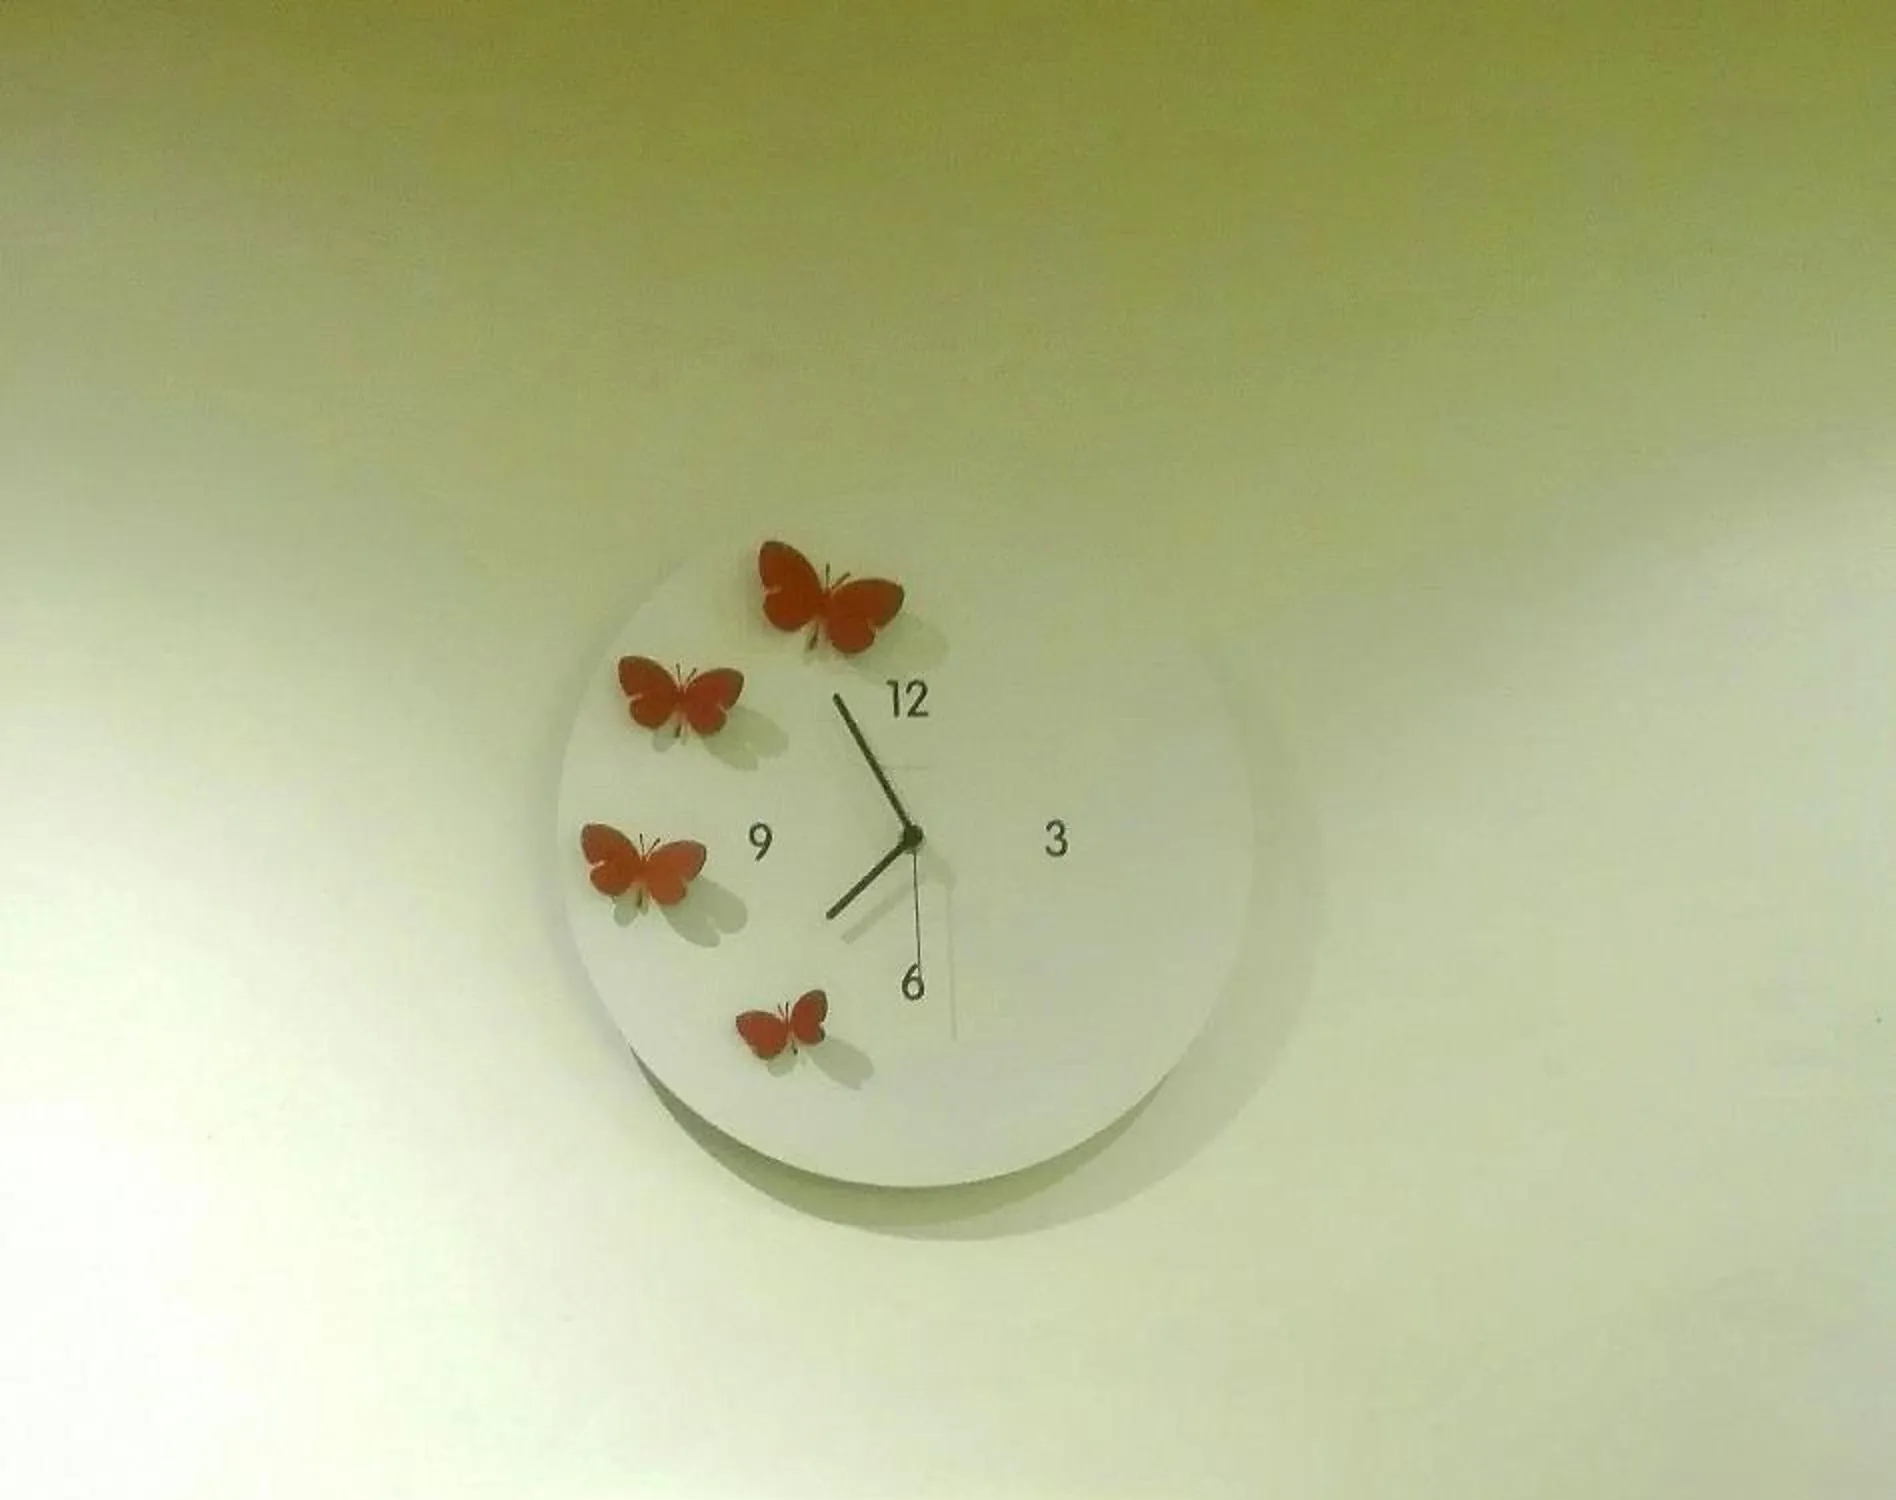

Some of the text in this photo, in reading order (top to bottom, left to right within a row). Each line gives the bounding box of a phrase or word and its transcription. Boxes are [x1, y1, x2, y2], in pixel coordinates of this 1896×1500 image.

[886, 679, 929, 717] 12
[749, 822, 773, 861] 9
[1046, 820, 1069, 857] 3
[902, 963, 925, 1001] 6
